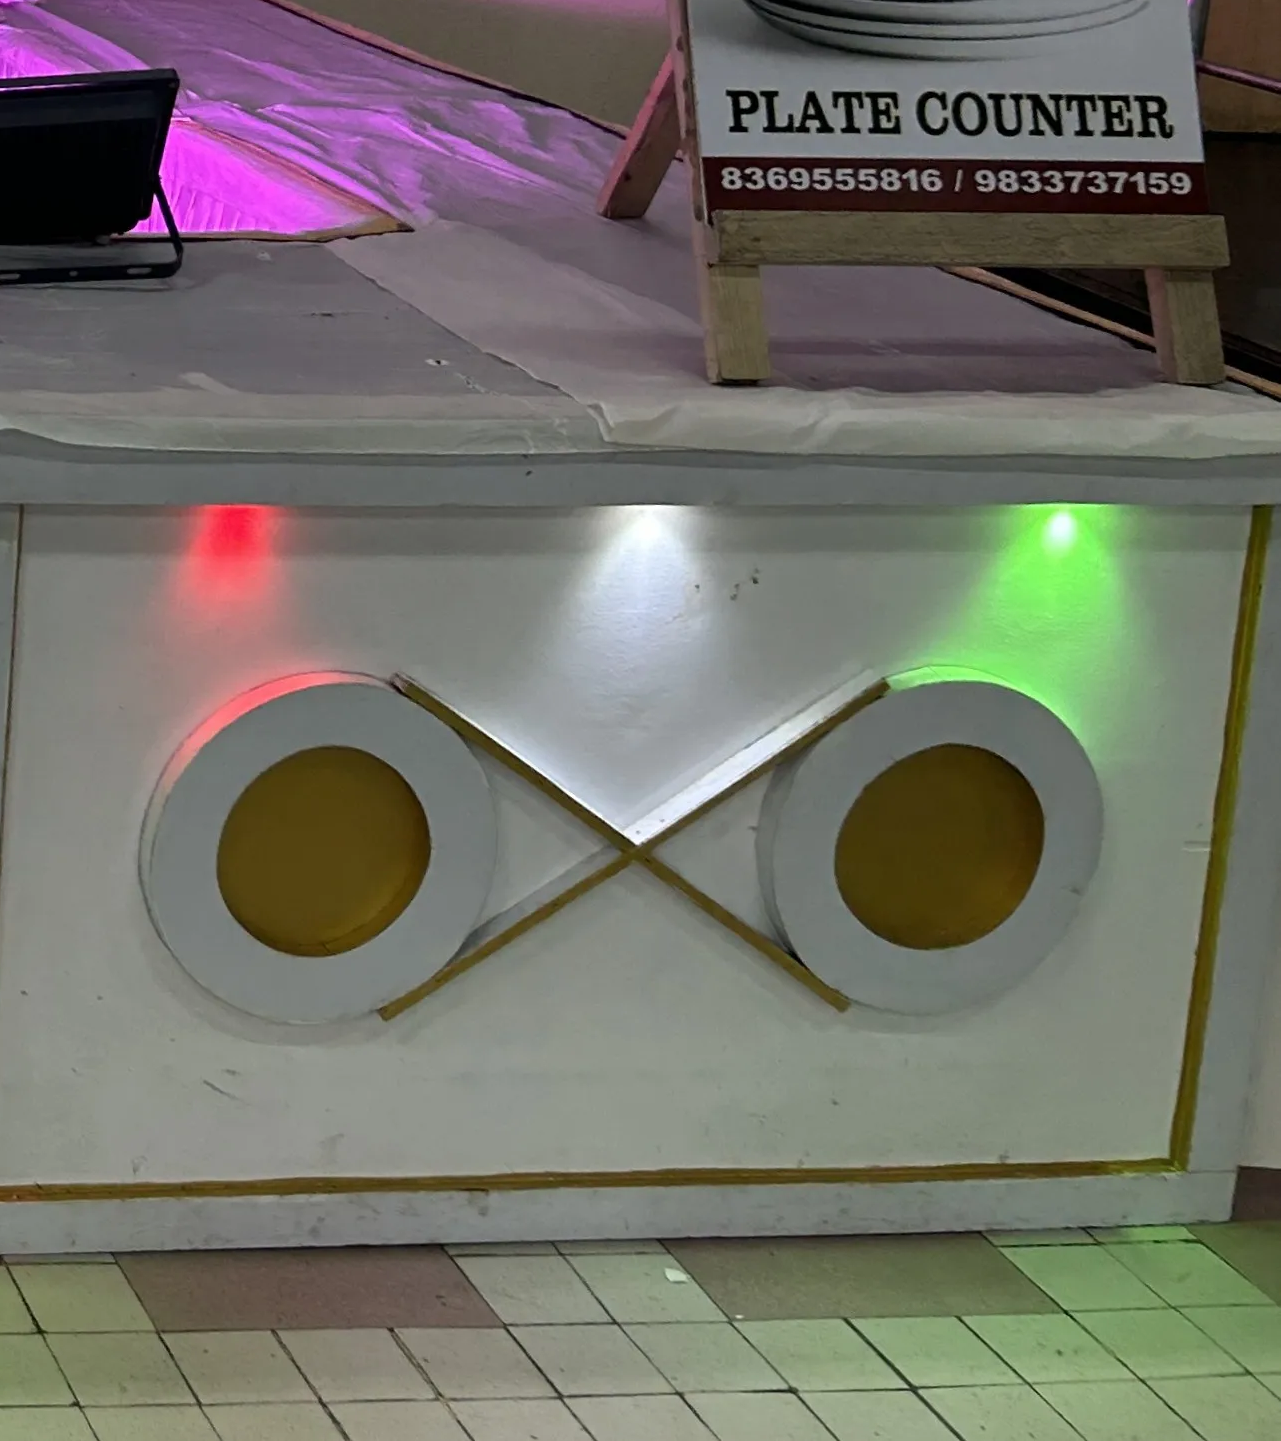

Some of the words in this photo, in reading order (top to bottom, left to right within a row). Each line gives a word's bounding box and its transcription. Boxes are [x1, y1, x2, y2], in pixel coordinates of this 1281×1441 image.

[726, 90, 901, 135] PLATE
[916, 91, 1174, 139] COUNTER
[721, 167, 943, 192] 8369555816
[954, 169, 964, 192] /
[974, 169, 1192, 195] 9833737159
